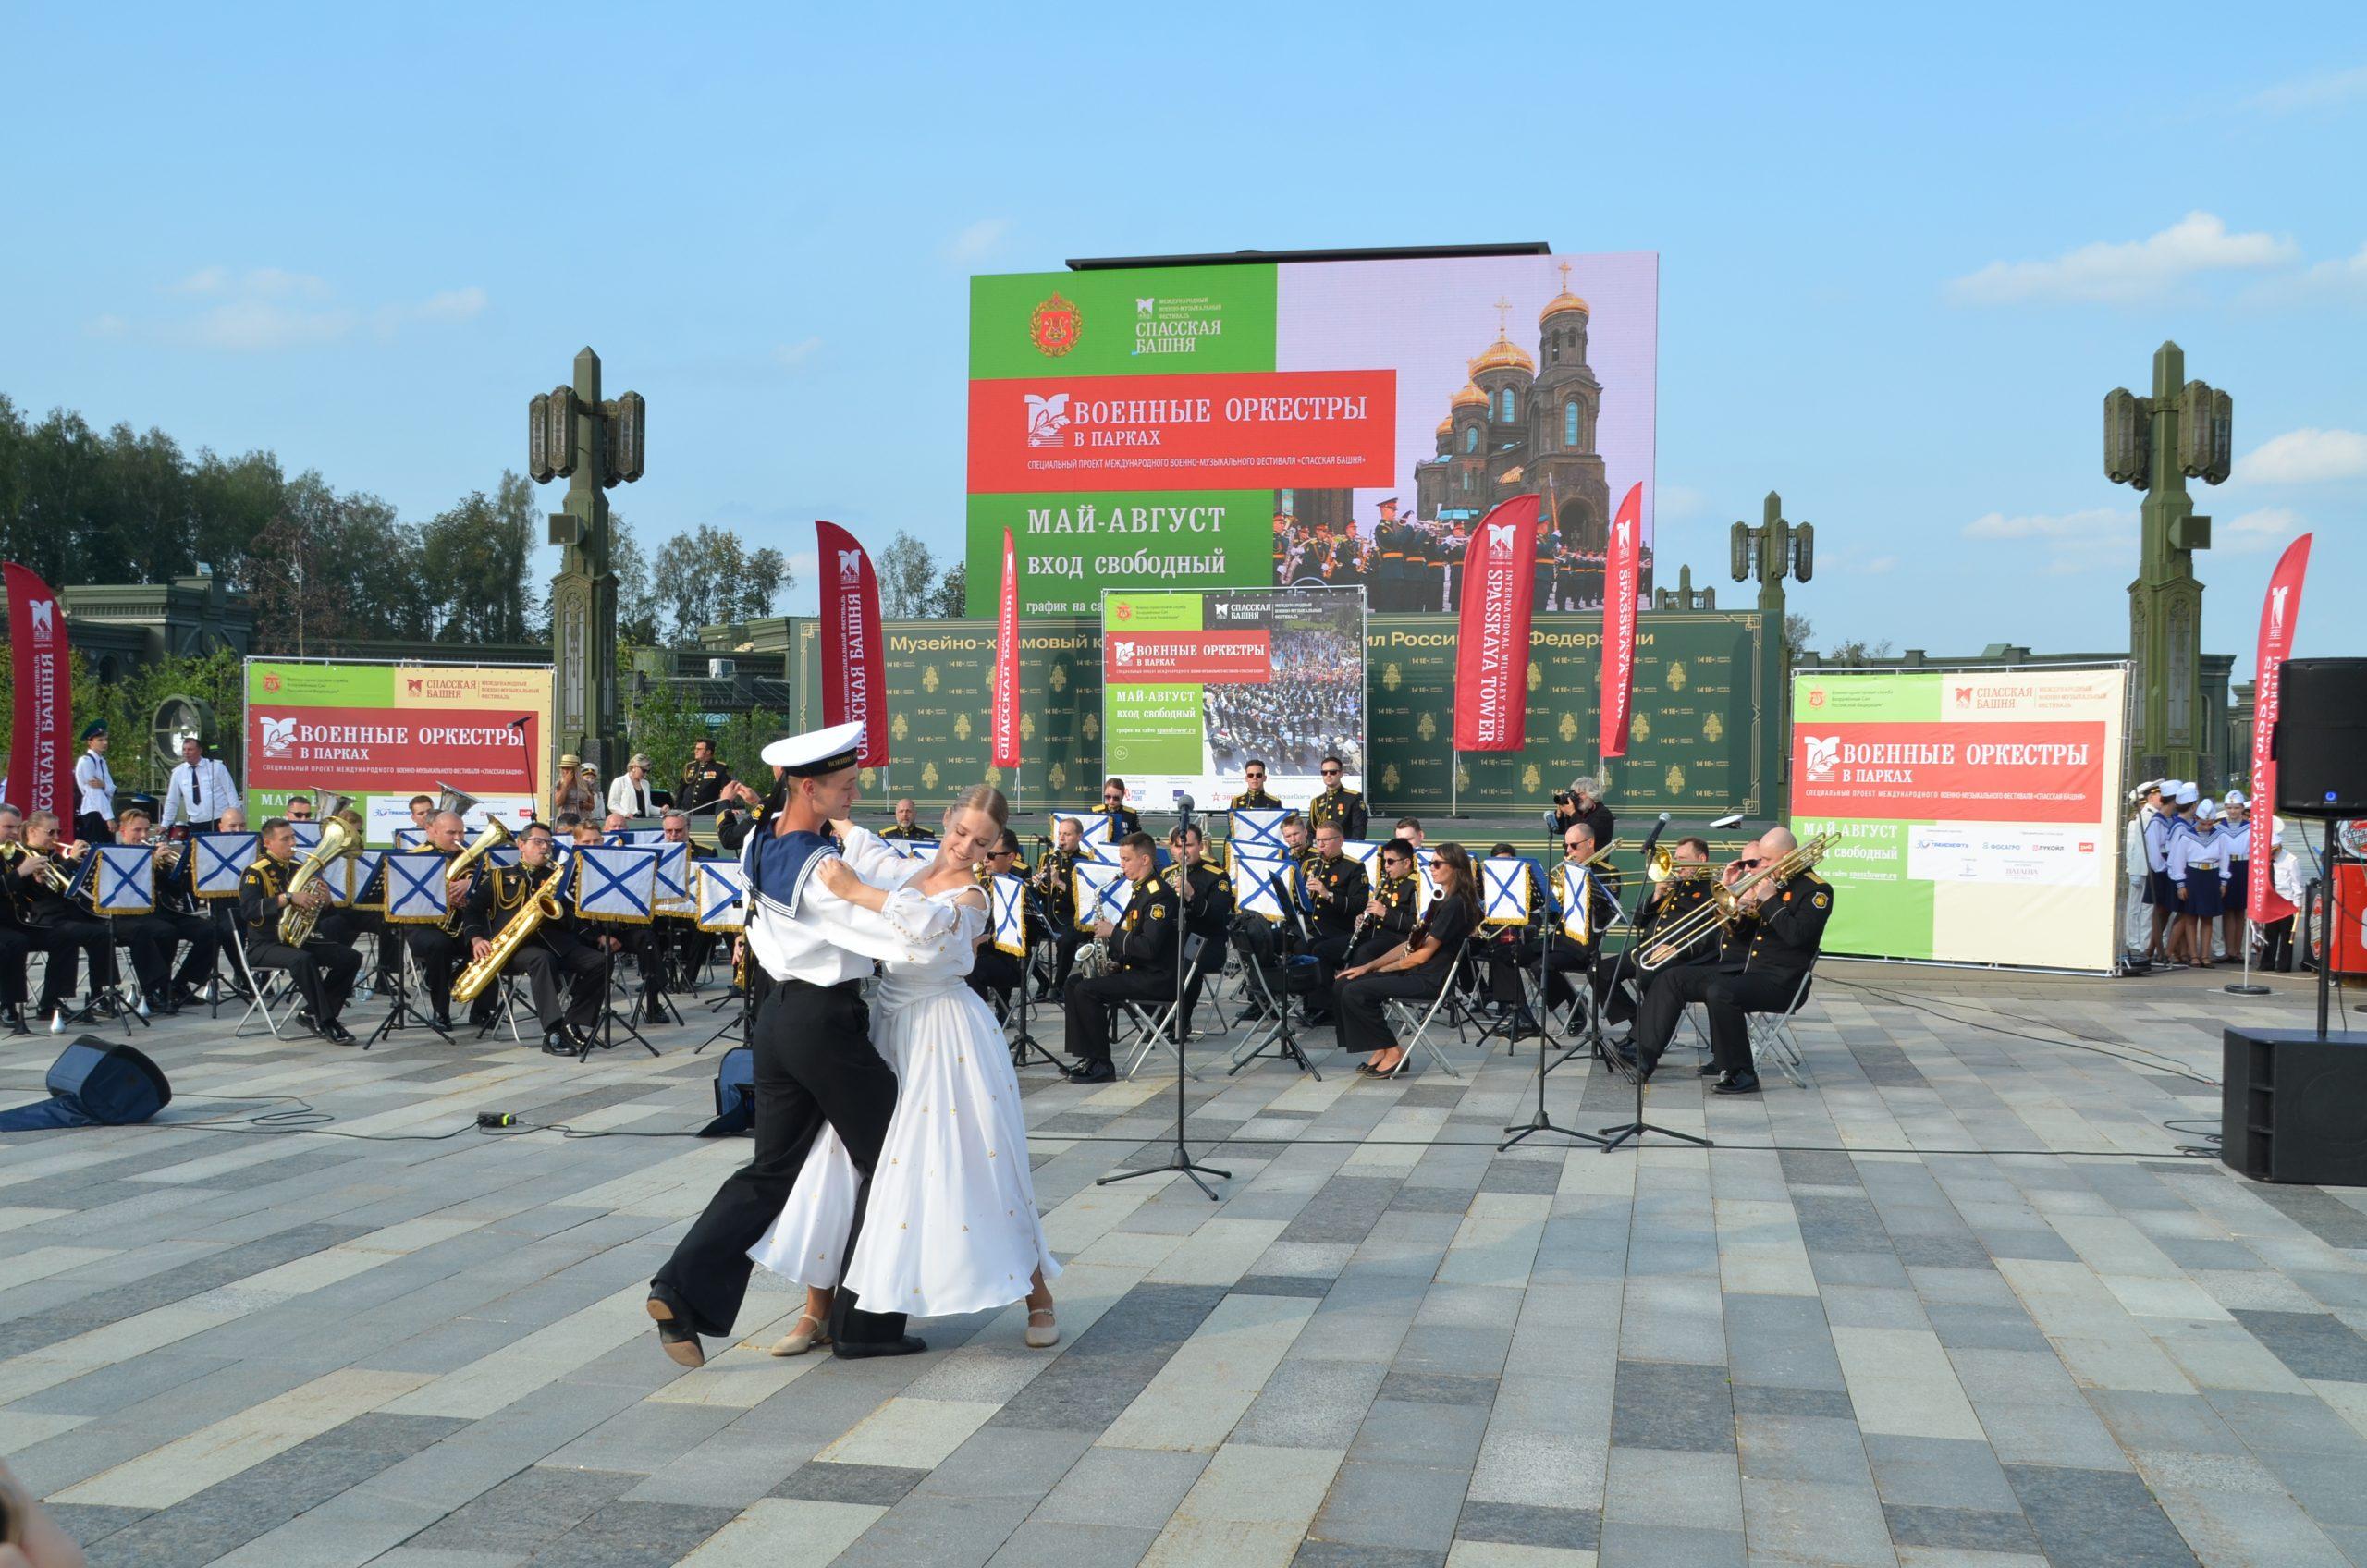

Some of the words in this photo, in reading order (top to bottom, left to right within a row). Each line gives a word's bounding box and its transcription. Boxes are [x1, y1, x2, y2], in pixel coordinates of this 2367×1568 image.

[1136, 319, 1221, 337] СПАССКАЯ
[1136, 337, 1196, 353] БАШНЯ
[1073, 399, 1211, 424] ВОЕННЫЕ
[1225, 396, 1367, 422] ОРКЕСТРЫ
[1073, 431, 1085, 447] В
[1091, 430, 1161, 447] ПАРКАХ
[1027, 459, 1077, 471] СПЕЦИАЛЬНЫЙ
[1079, 459, 1104, 469] ПРОЕКТ
[1105, 458, 1169, 469] МЕЖДУНАРОДНОГО
[1170, 456, 1255, 468] ВОЕННО-МУЗЫКАЛЬНОГО
[1256, 456, 1296, 466] ФЕСТИВАЛЯ
[1027, 504, 1225, 533] МАЙ-АВГУСТ
[1027, 556, 1083, 579] вход
[1095, 547, 1225, 579] свободный
[1026, 599, 1067, 614] график
[1073, 602, 1085, 611] на
[1231, 604, 1271, 612] СПАССКАЯ
[1502, 570, 1513, 649] INTERNATIONAL
[847, 593, 865, 659] БАШНЯ
[1481, 570, 1503, 672] SPASSKAYA
[1618, 570, 1628, 677] SPASSKAYA
[891, 634, 1087, 654] Музейно-хмовый
[1391, 631, 1459, 647] Росси
[1136, 644, 1197, 656] ВОЕННЫЕ
[1203, 644, 1265, 656] ОРКЕСТРЫ
[427, 680, 476, 689] СПАССКАЯ
[1499, 654, 1509, 701] MILITARY
[42, 653, 54, 732] БАШНЯ
[427, 690, 461, 699] БАШНЯ
[1977, 687, 2032, 698] СПАССКАЯ
[1000, 666, 1010, 760] СПАССКАЯ
[1116, 709, 1139, 719] вход
[1144, 707, 1196, 719] свободный
[1478, 676, 1498, 742] TOWER
[1977, 699, 2016, 709] БАШНЯ
[1496, 704, 1506, 742] TATTOO
[300, 725, 408, 744] ВОЕННЫЕ
[419, 727, 525, 747] ОРКЕСТРЫ
[300, 747, 309, 758] В
[314, 747, 370, 760] ПАРКАХ
[1843, 743, 1955, 765] ВОЕННЫЕ
[1966, 743, 2089, 766] ОРКЕСТРЫ
[39, 740, 54, 813] ССКАЯ
[1843, 769, 1851, 782] В
[1856, 769, 1913, 782] ПАРКАХ
[1834, 845, 1897, 861] свободный
